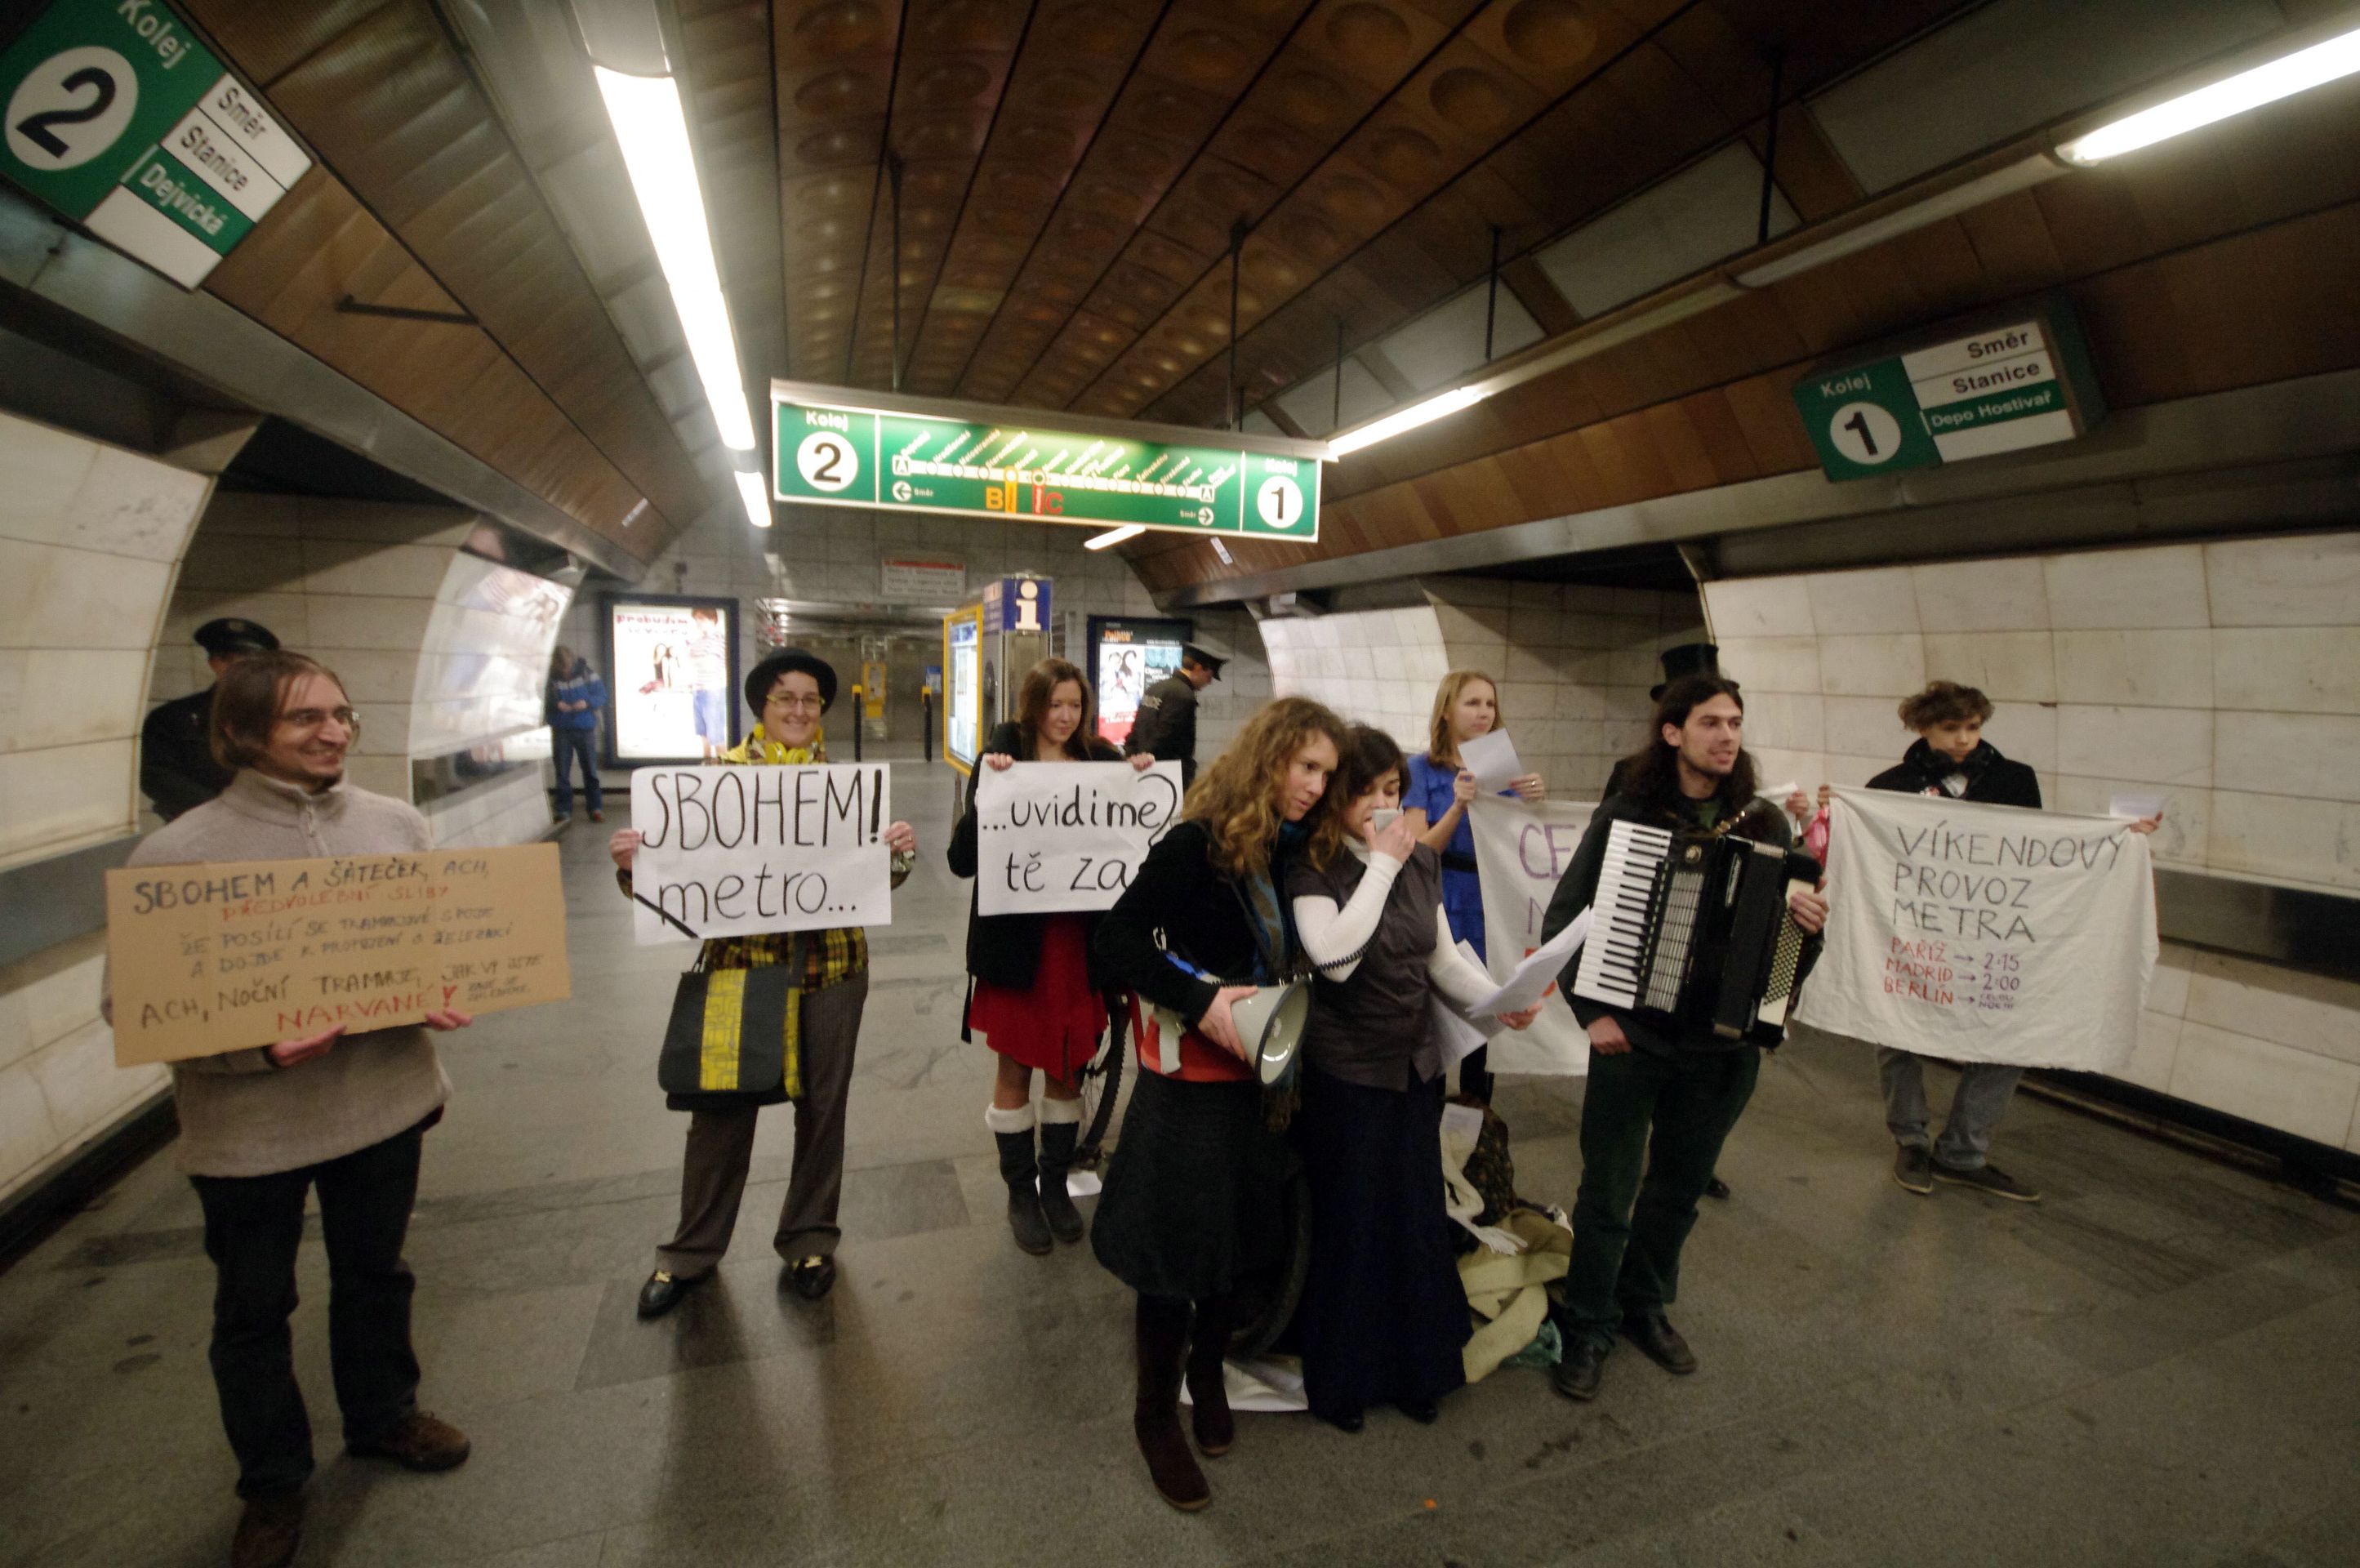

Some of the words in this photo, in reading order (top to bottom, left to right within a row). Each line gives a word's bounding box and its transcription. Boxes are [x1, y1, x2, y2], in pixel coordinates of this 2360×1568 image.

[118, 0, 191, 69] Kolej
[16, 66, 116, 159] 2
[218, 86, 266, 140] Směr
[180, 126, 248, 191] Stanice
[140, 163, 228, 236] Dejvická
[1967, 330, 2029, 359] Směr
[1820, 372, 1872, 399] Kolej
[1953, 361, 2041, 394] Stanice
[805, 410, 848, 432] Kolej
[1844, 410, 1878, 457] 1
[1931, 408, 1975, 428] Depo
[813, 442, 841, 483] 2
[986, 486, 1004, 510] B
[1045, 492, 1064, 514] C
[1271, 487, 1285, 520] 1
[642, 768, 883, 850] SBOHEM!
[133, 871, 275, 915] SBOHEM
[291, 871, 309, 892] A
[443, 860, 489, 880] ACH,
[658, 862, 856, 925] metro...
[1006, 852, 1045, 892] tě
[1894, 862, 2032, 909] PROVOZ
[1893, 898, 2036, 942] METRA
[1886, 957, 1953, 982] MADRID
[140, 996, 209, 1029] ACH,
[217, 974, 290, 1012] NOČNÍ
